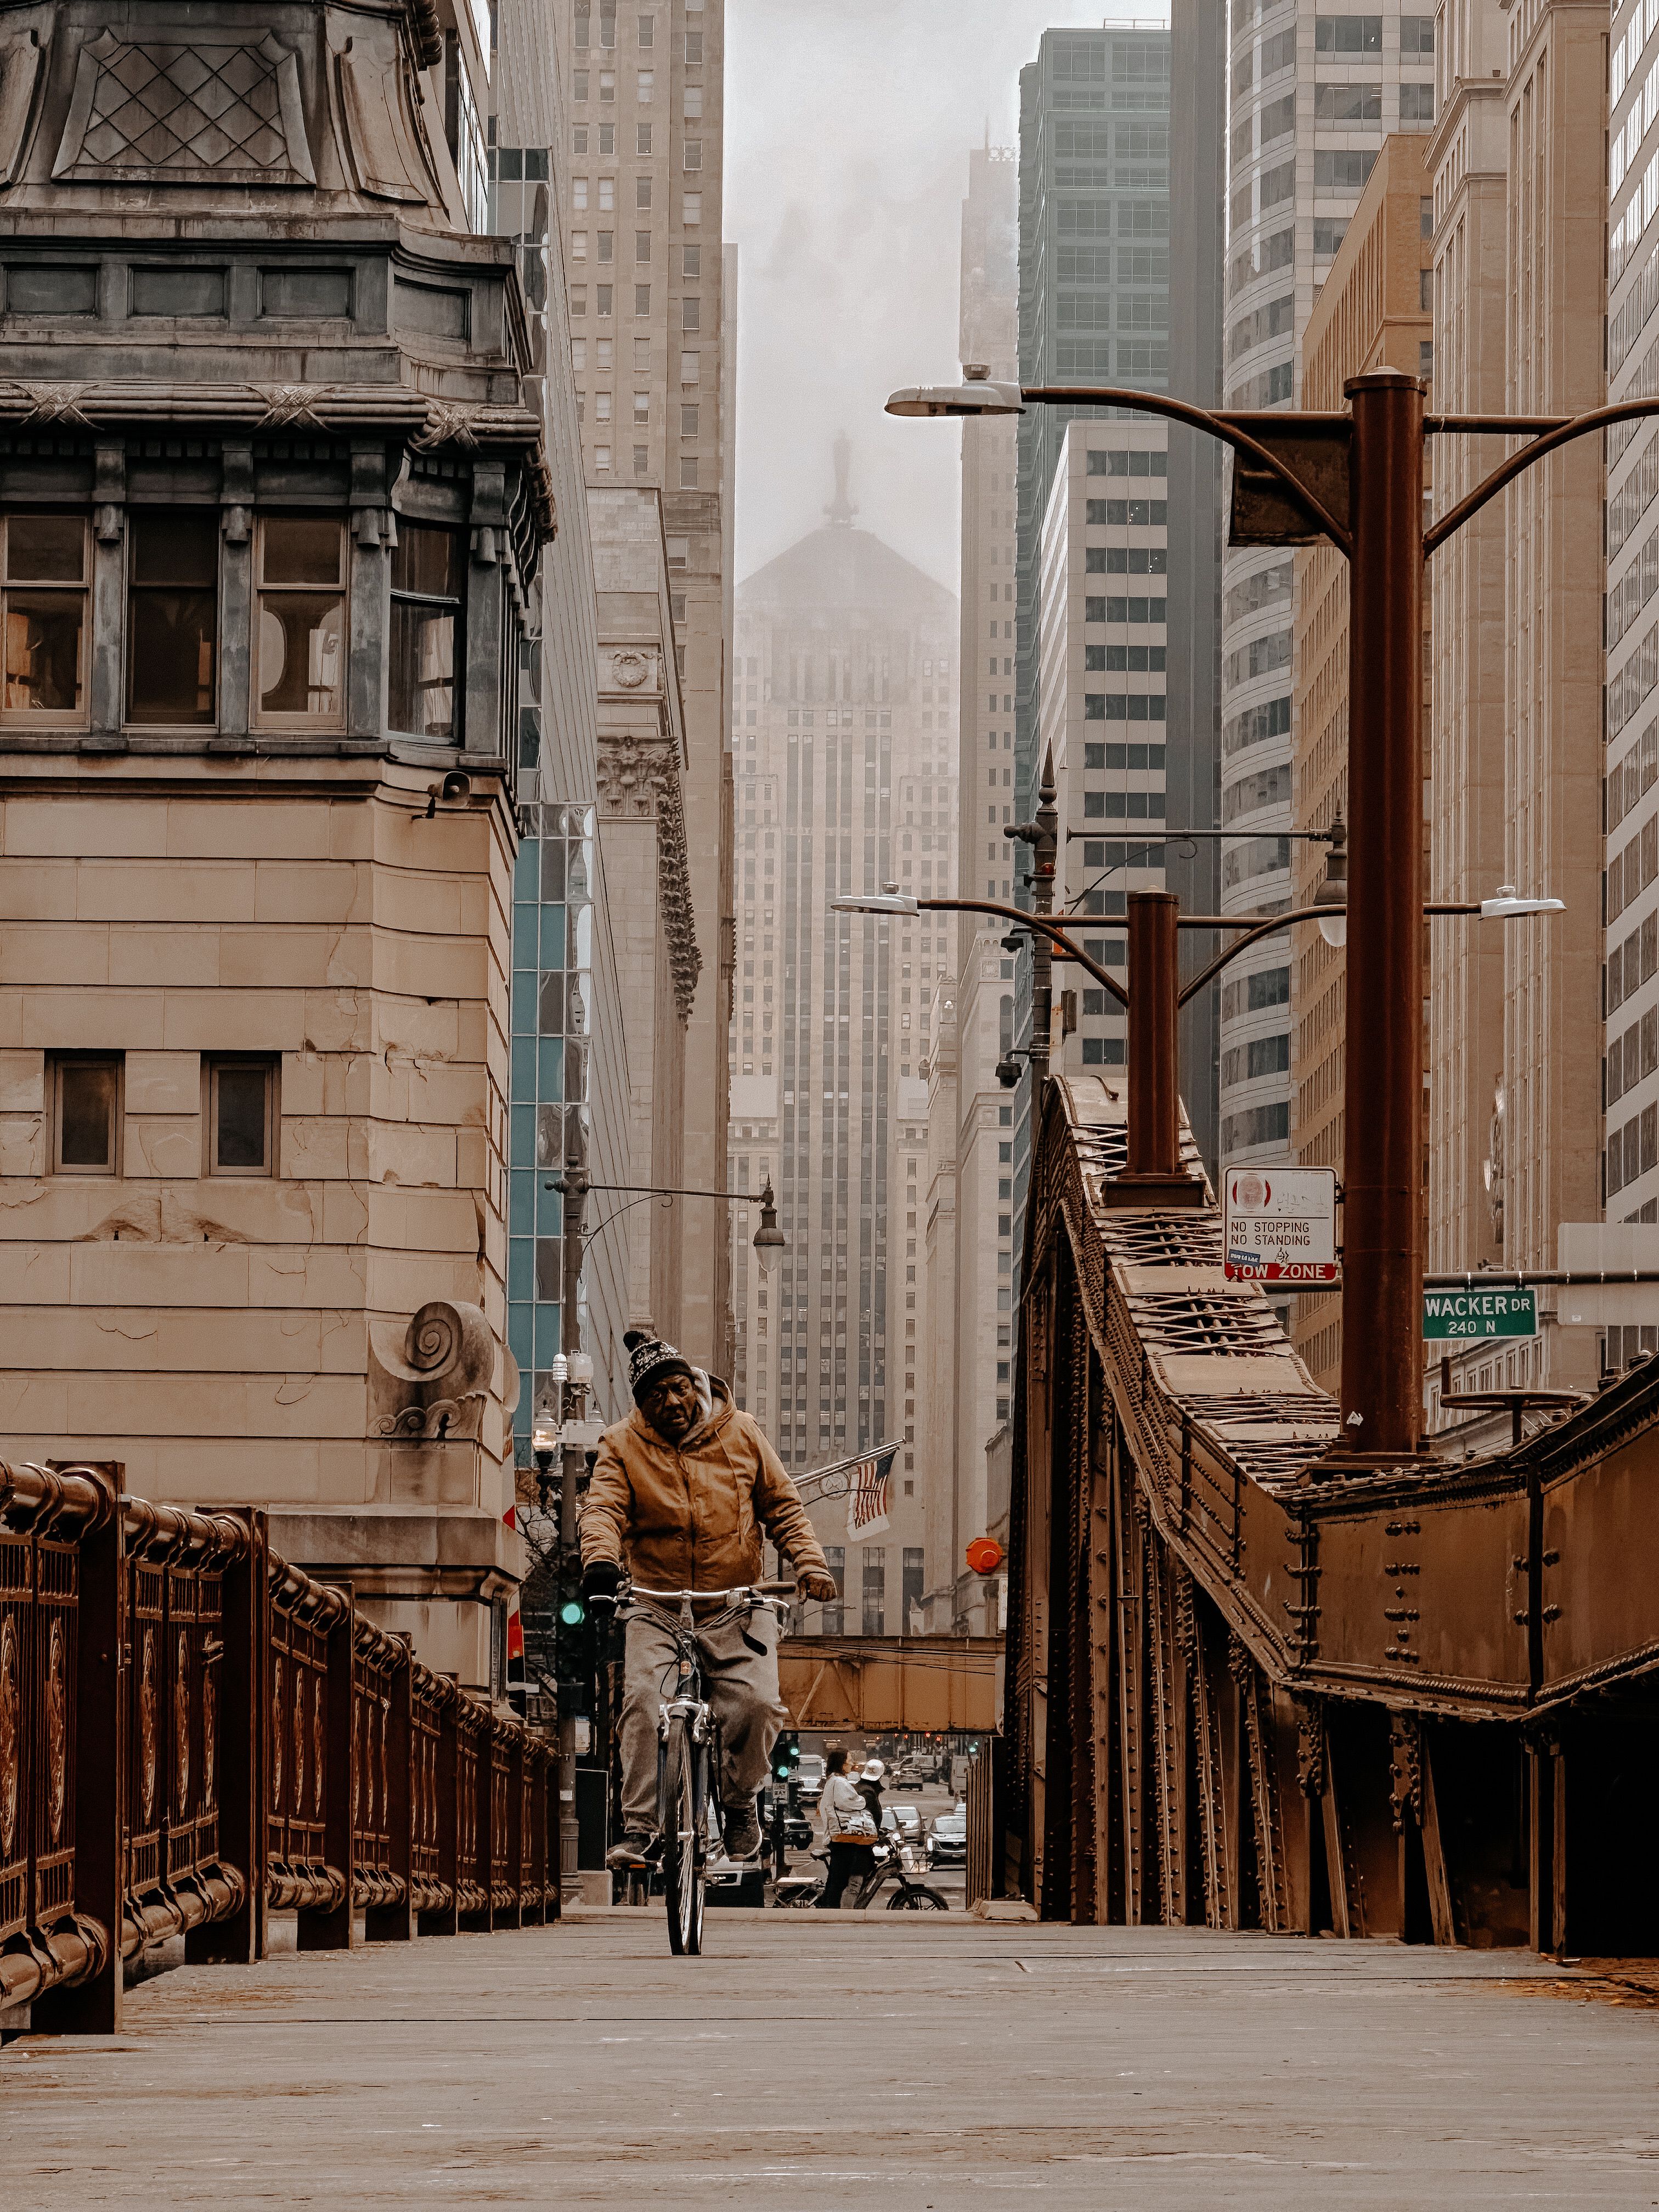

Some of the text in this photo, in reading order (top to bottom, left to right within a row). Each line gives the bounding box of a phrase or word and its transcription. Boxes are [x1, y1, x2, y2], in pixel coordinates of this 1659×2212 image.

[1232, 1222, 1310, 1233] NO STOPPING
[1231, 1234, 1310, 1245] NO STANDING
[1278, 1265, 1326, 1278] ZONE
[1425, 1296, 1531, 1317] WACKER DR
[1448, 1320, 1496, 1334] 240 N
